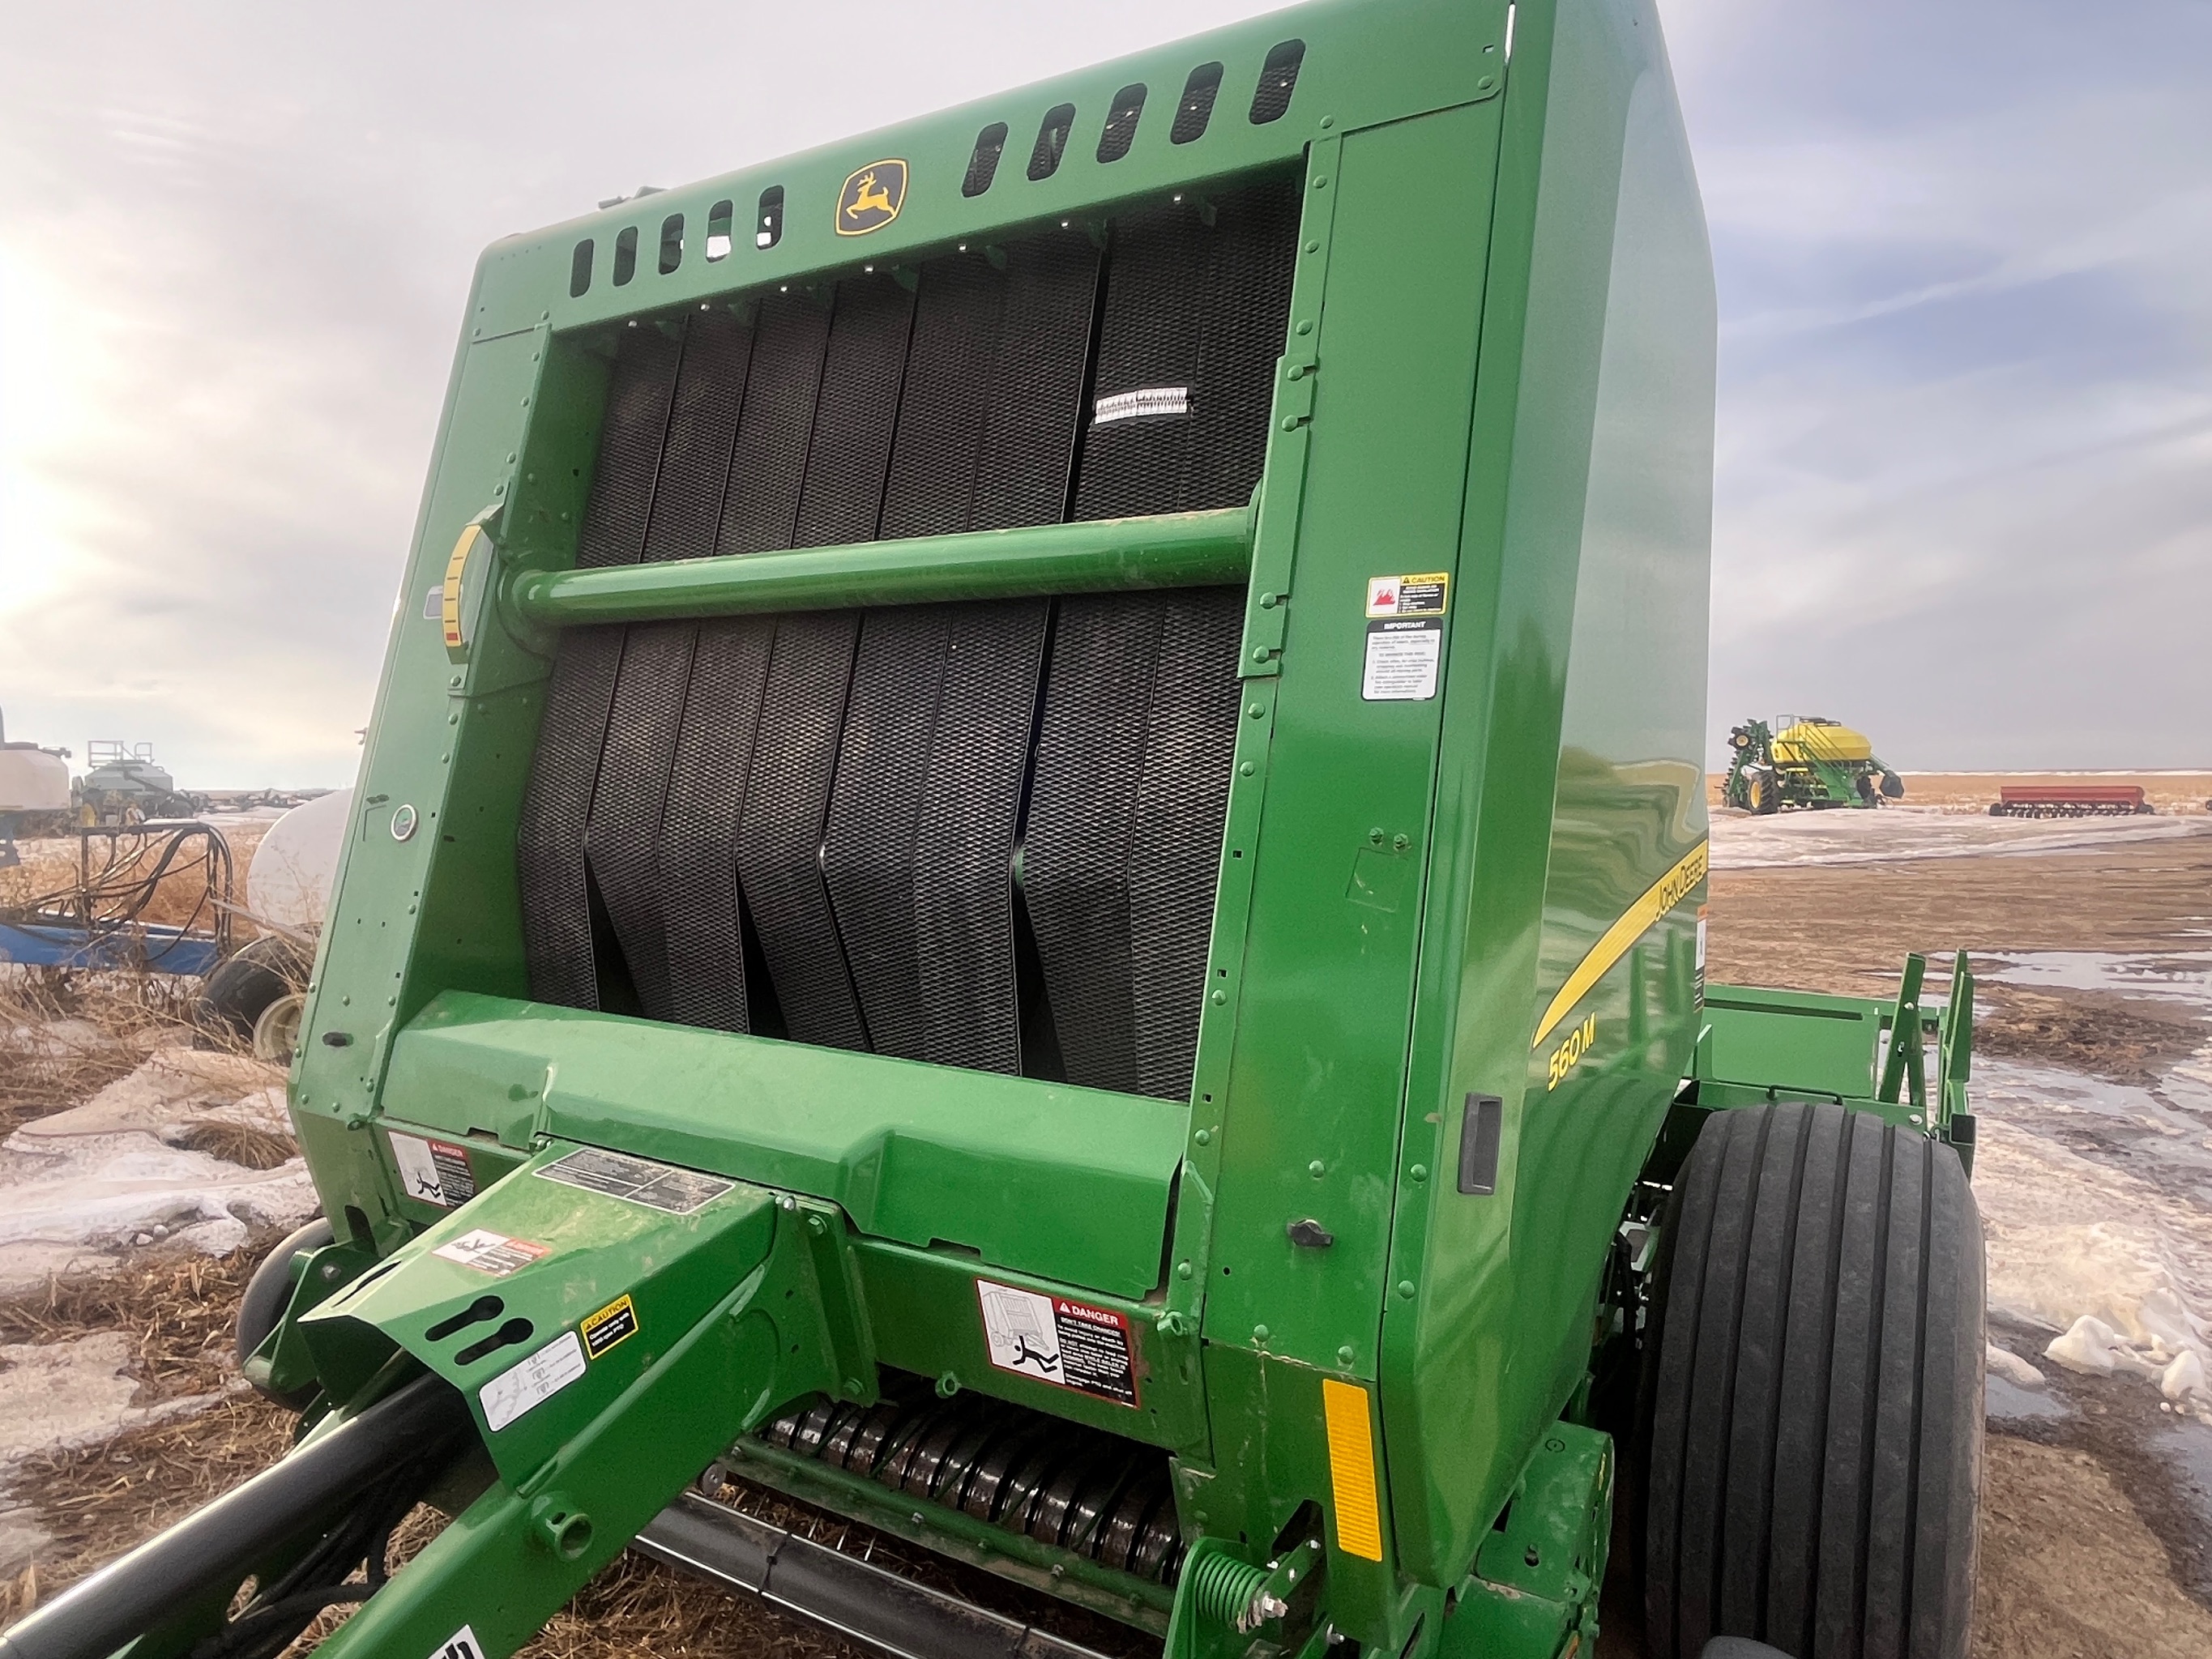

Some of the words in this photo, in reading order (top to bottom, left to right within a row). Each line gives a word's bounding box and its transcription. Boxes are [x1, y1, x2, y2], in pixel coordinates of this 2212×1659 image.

[1384, 621, 1426, 629] IMPORTANT
[1655, 877, 1679, 918] JOHN
[1680, 855, 1703, 895] DEERE
[1548, 1029, 1580, 1092] 560
[1582, 1012, 1595, 1053] M
[591, 1300, 627, 1326] CAUTION
[1071, 1305, 1118, 1325] DANGER
